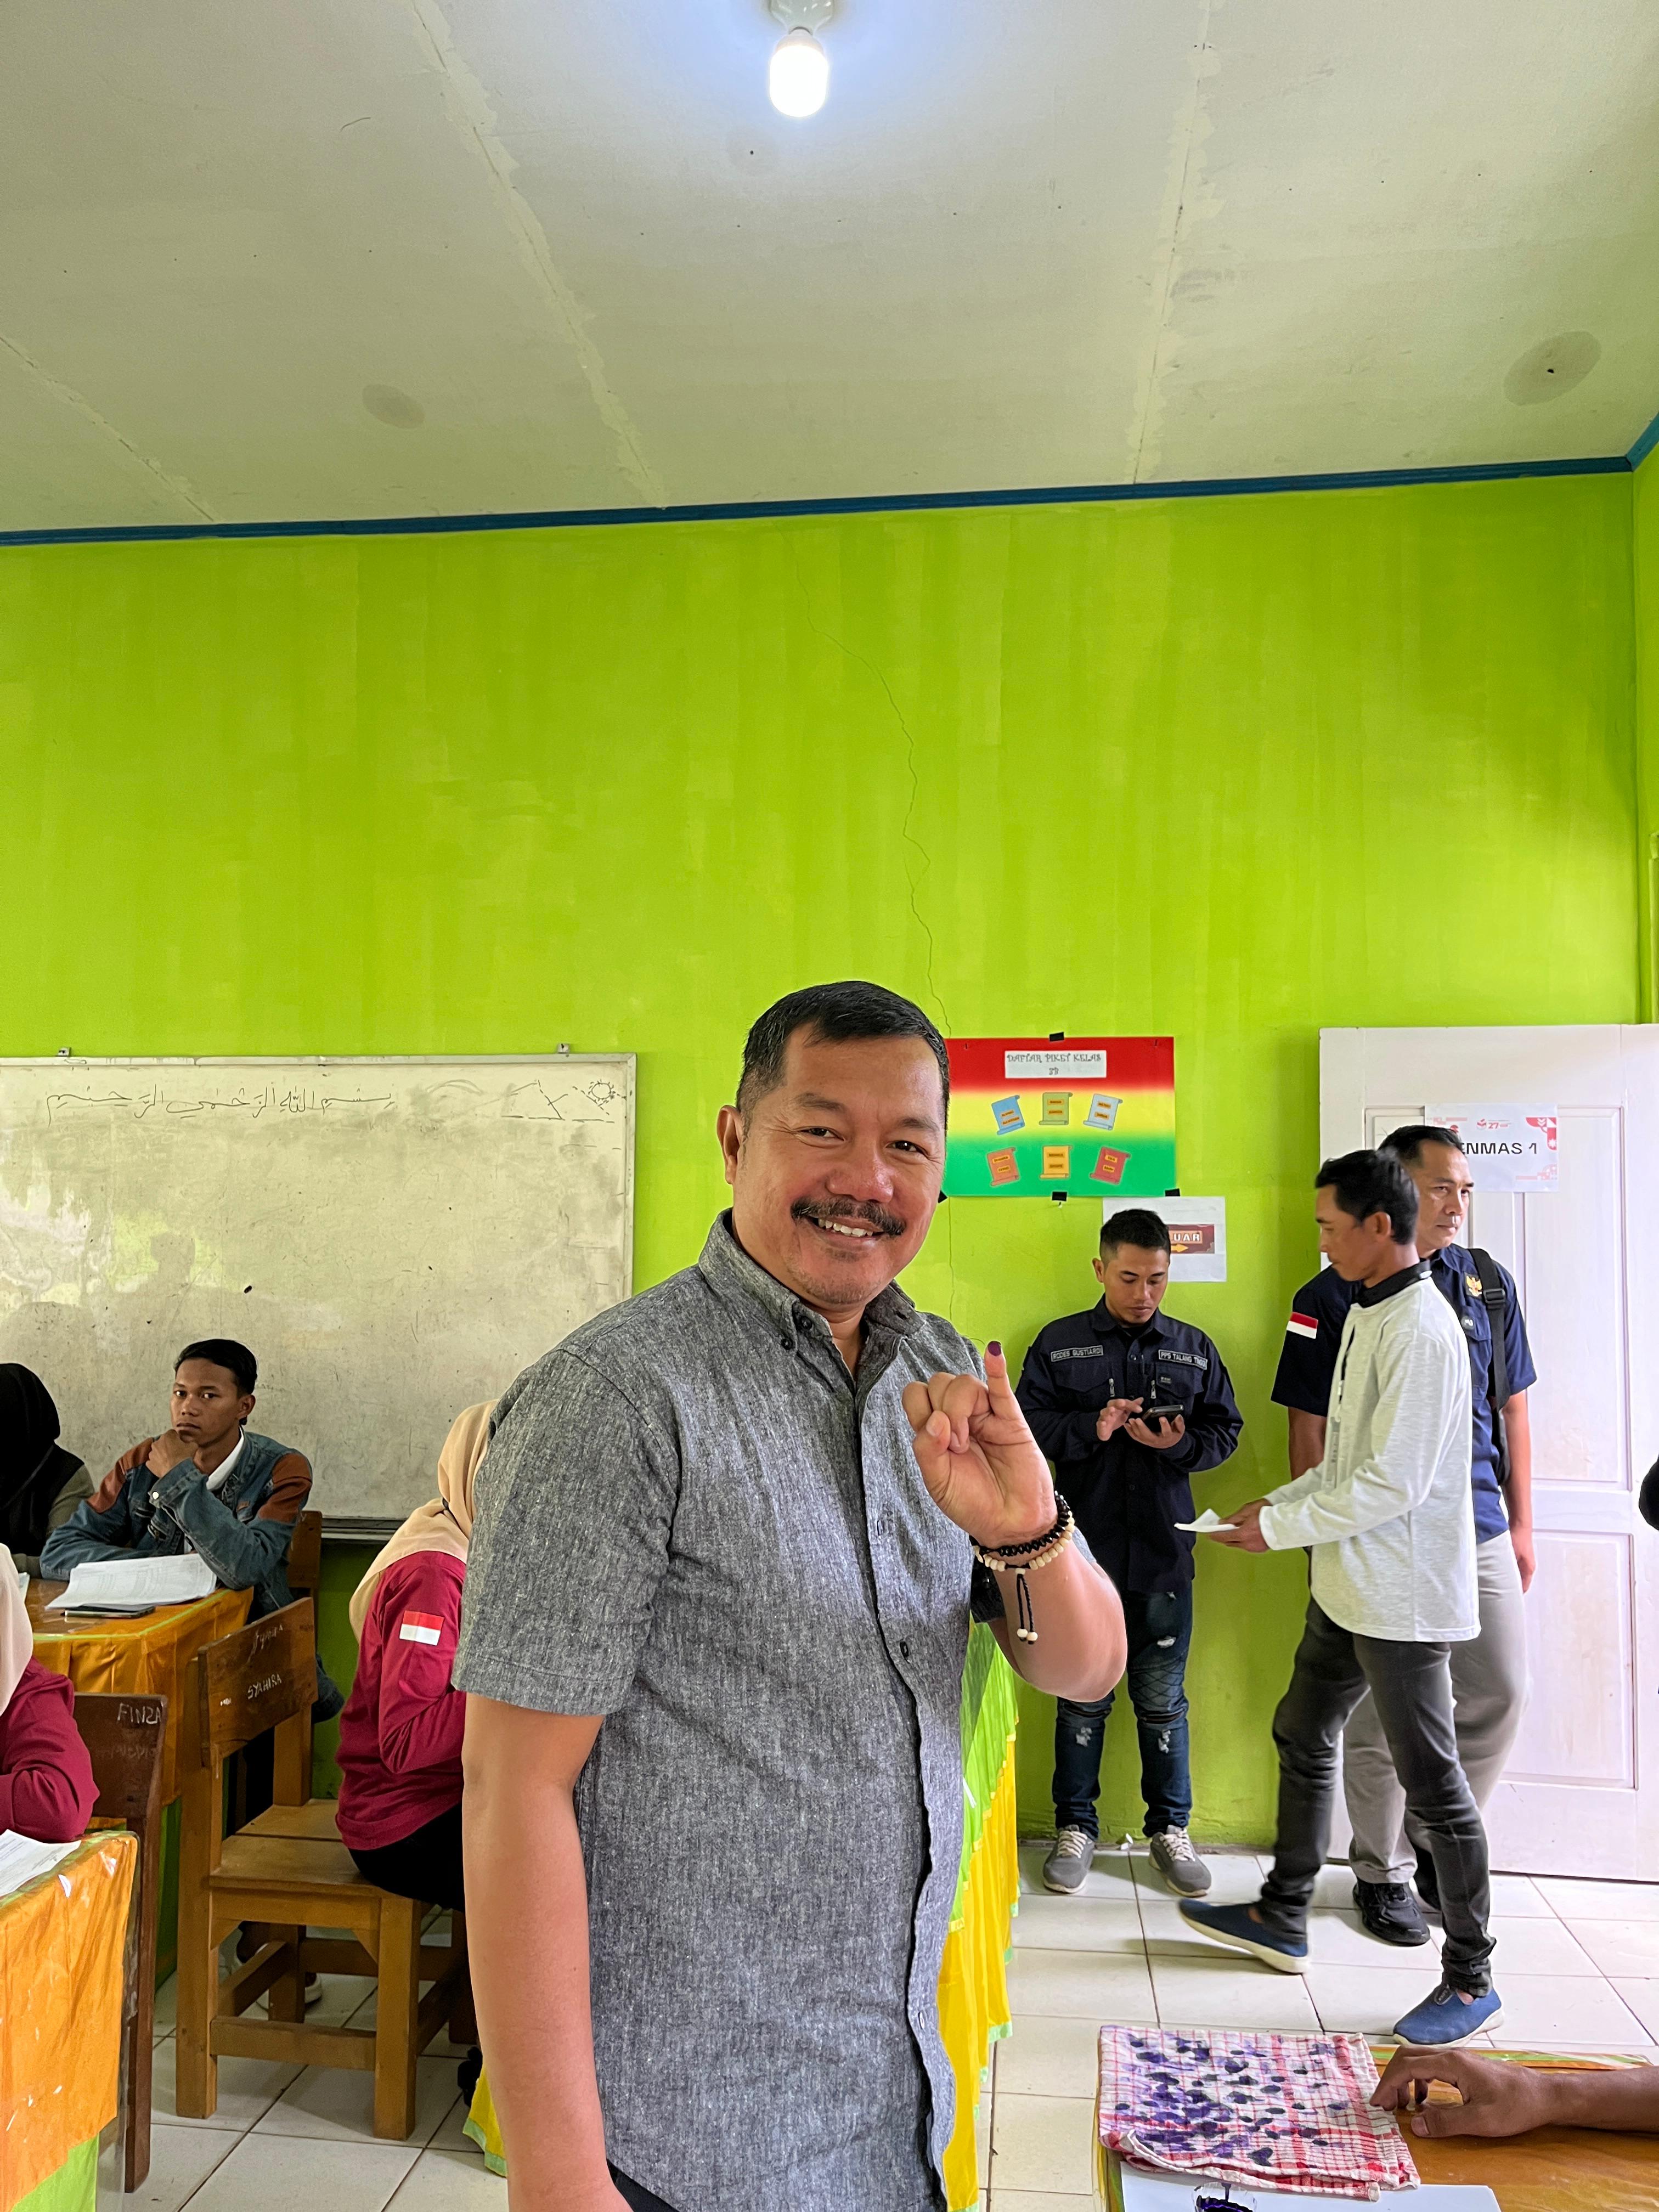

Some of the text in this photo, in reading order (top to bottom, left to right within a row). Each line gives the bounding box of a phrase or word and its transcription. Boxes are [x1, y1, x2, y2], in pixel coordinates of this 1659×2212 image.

[1007, 1053, 1042, 1063] DAFTAR
[1045, 1053, 1070, 1062] PIKET
[1528, 1143, 1537, 1154] 1
[1172, 1233, 1200, 1242] UAR
